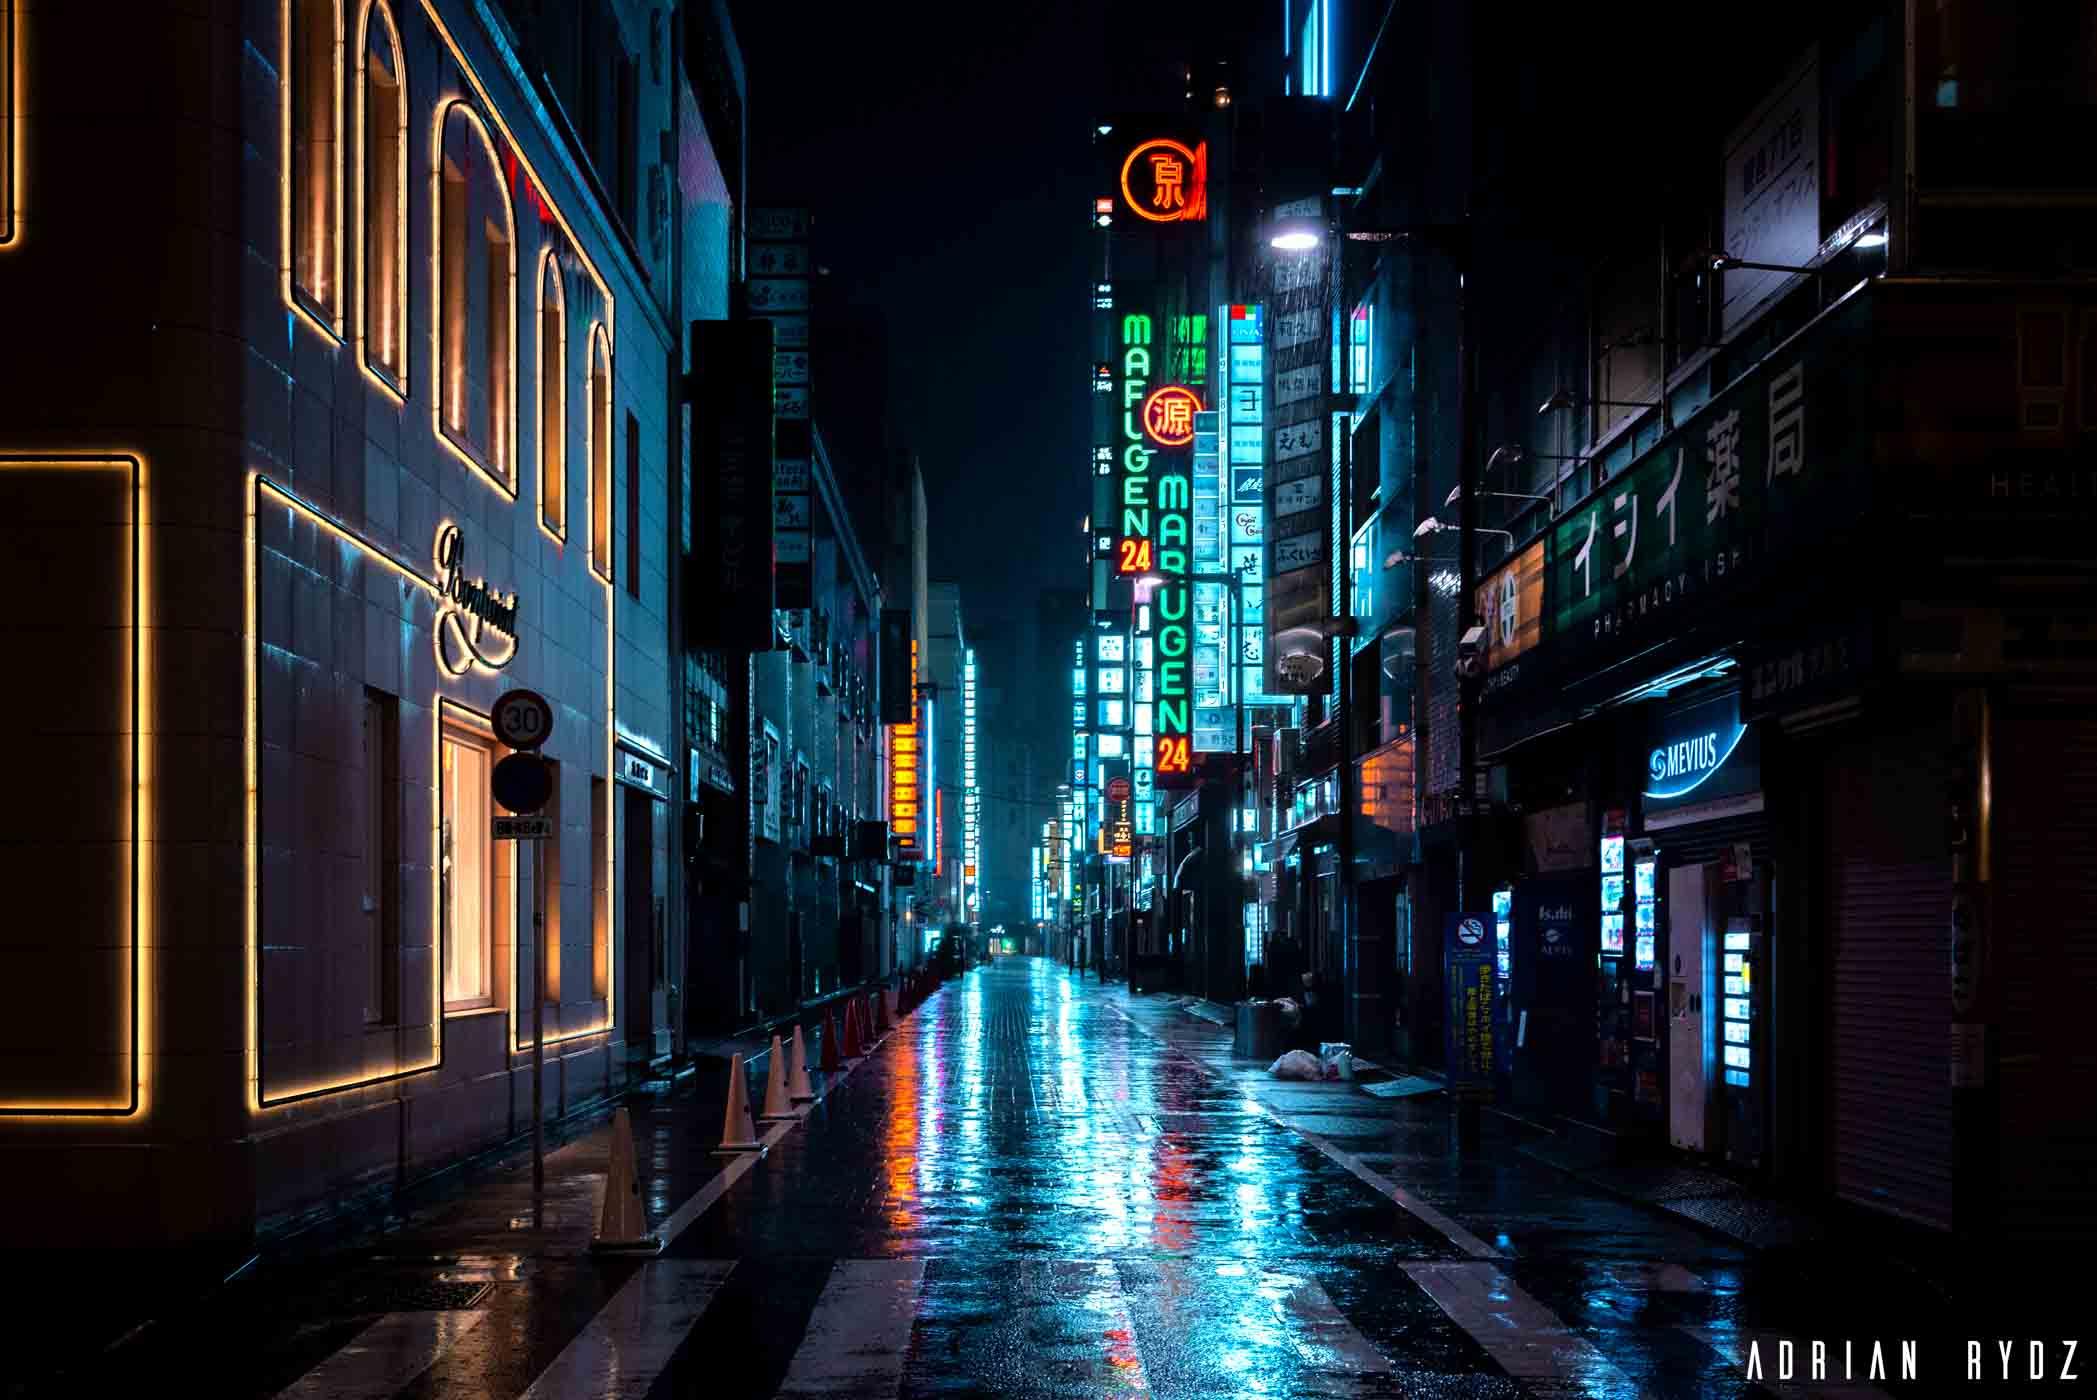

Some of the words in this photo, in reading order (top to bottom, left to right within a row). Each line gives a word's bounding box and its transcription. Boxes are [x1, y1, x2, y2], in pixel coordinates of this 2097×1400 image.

[1120, 539, 1152, 573] 24
[1158, 474, 1189, 734] MARUGEN
[505, 706, 539, 734] 30
[1157, 736, 1191, 772] 24
[1666, 732, 1718, 777] MEVIUS
